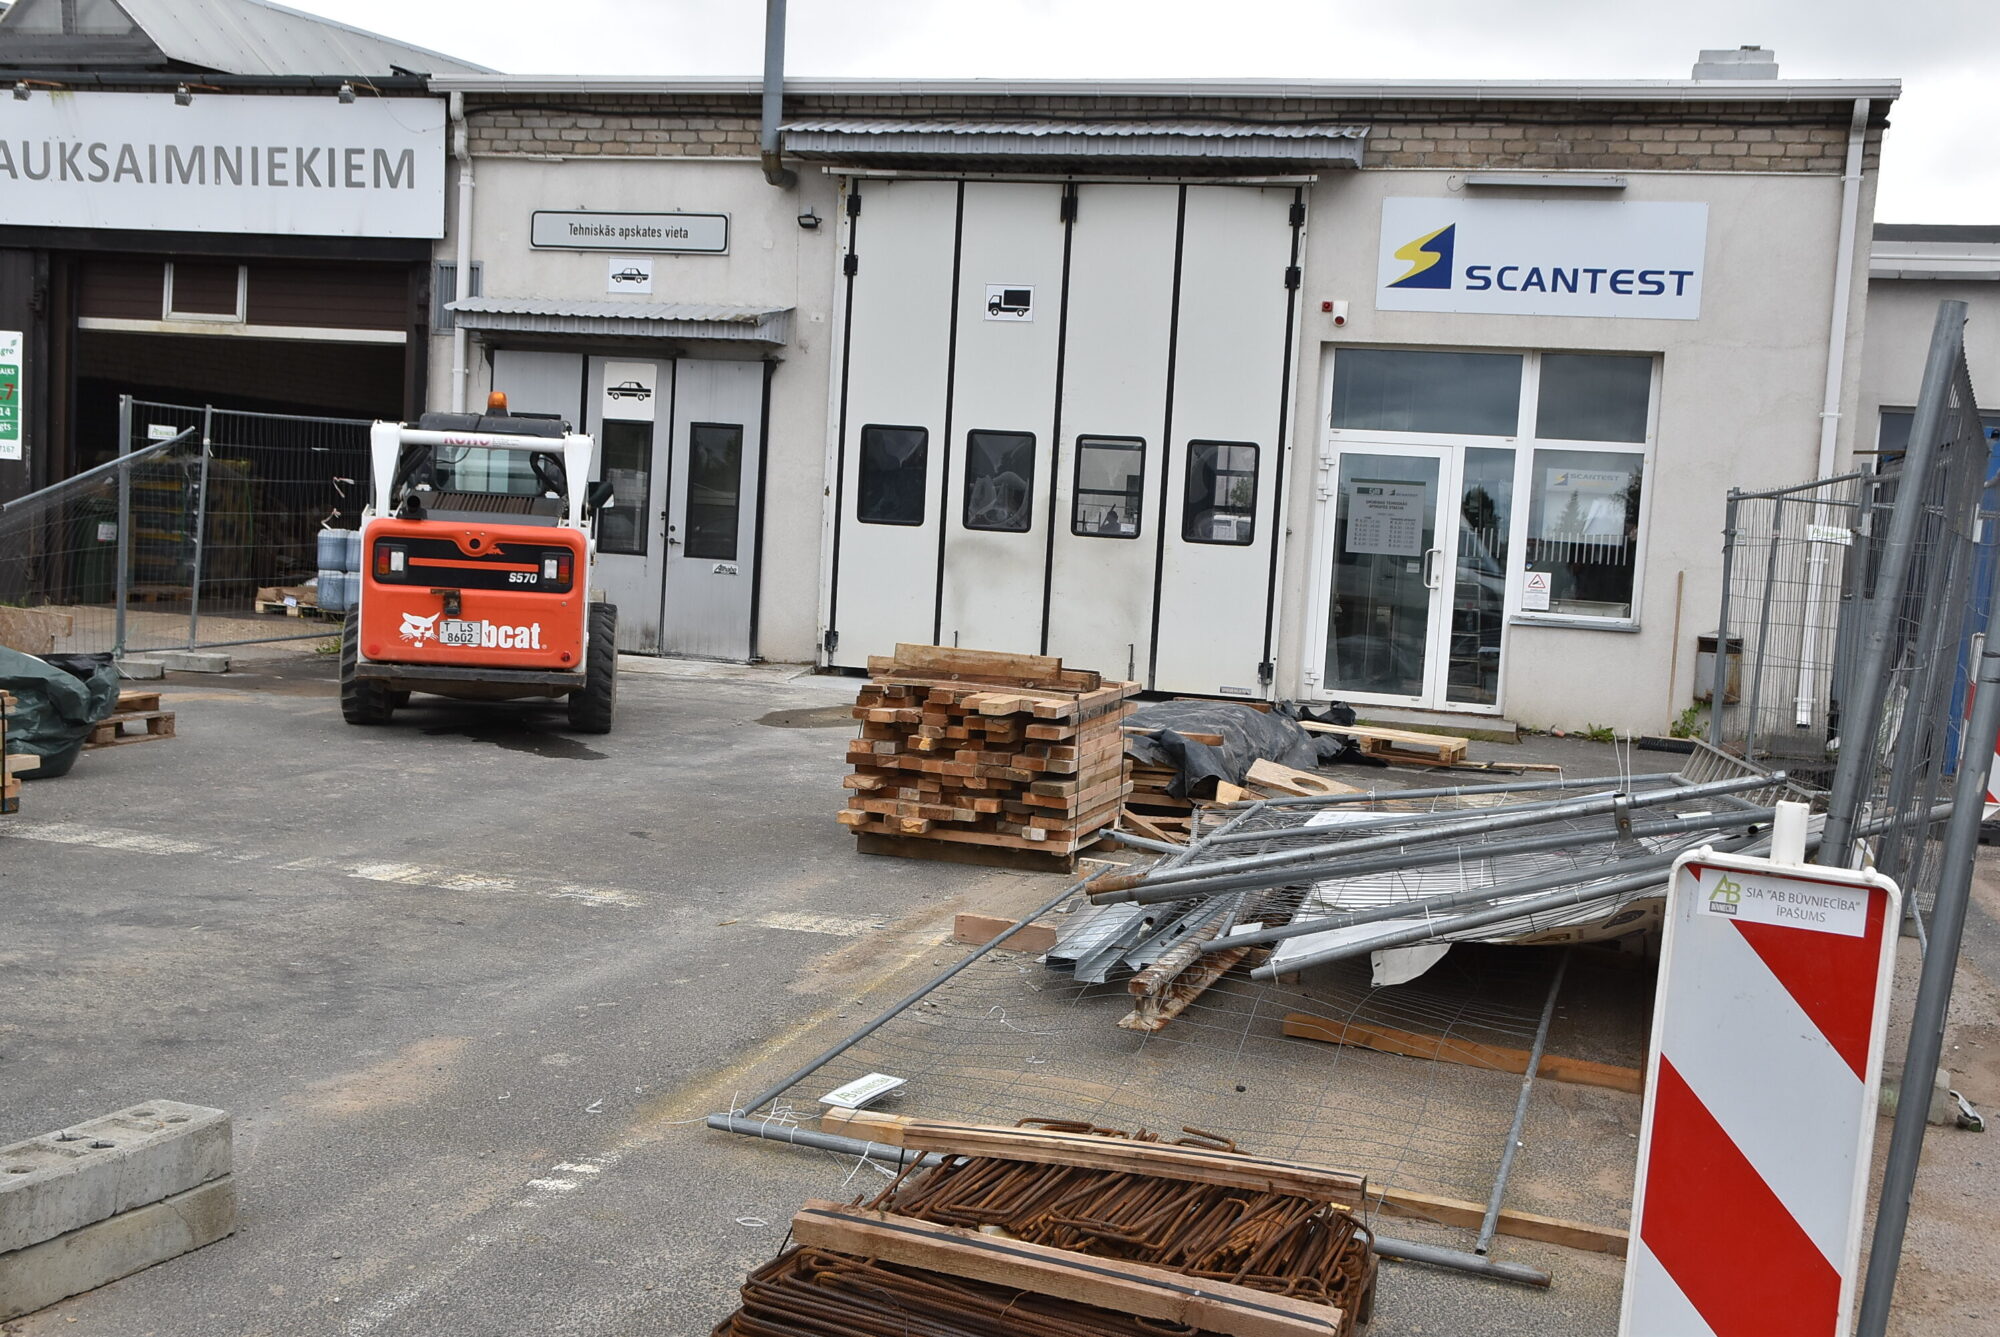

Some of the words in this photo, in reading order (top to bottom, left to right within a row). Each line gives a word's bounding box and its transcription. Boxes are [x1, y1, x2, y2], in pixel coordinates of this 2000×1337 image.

[0, 140, 415, 189] AUKSAIMNIEKIEM
[568, 223, 616, 237] Tehniskās
[618, 225, 662, 240] apskates
[665, 226, 689, 239] vieta
[1465, 265, 1694, 296] SCANTEST
[509, 572, 538, 584] S570
[444, 622, 451, 632] T
[460, 623, 474, 632] LS
[447, 619, 541, 650] bcat
[447, 632, 474, 643] 8602
[1709, 874, 1741, 904] AB
[1746, 887, 1764, 899] SIA
